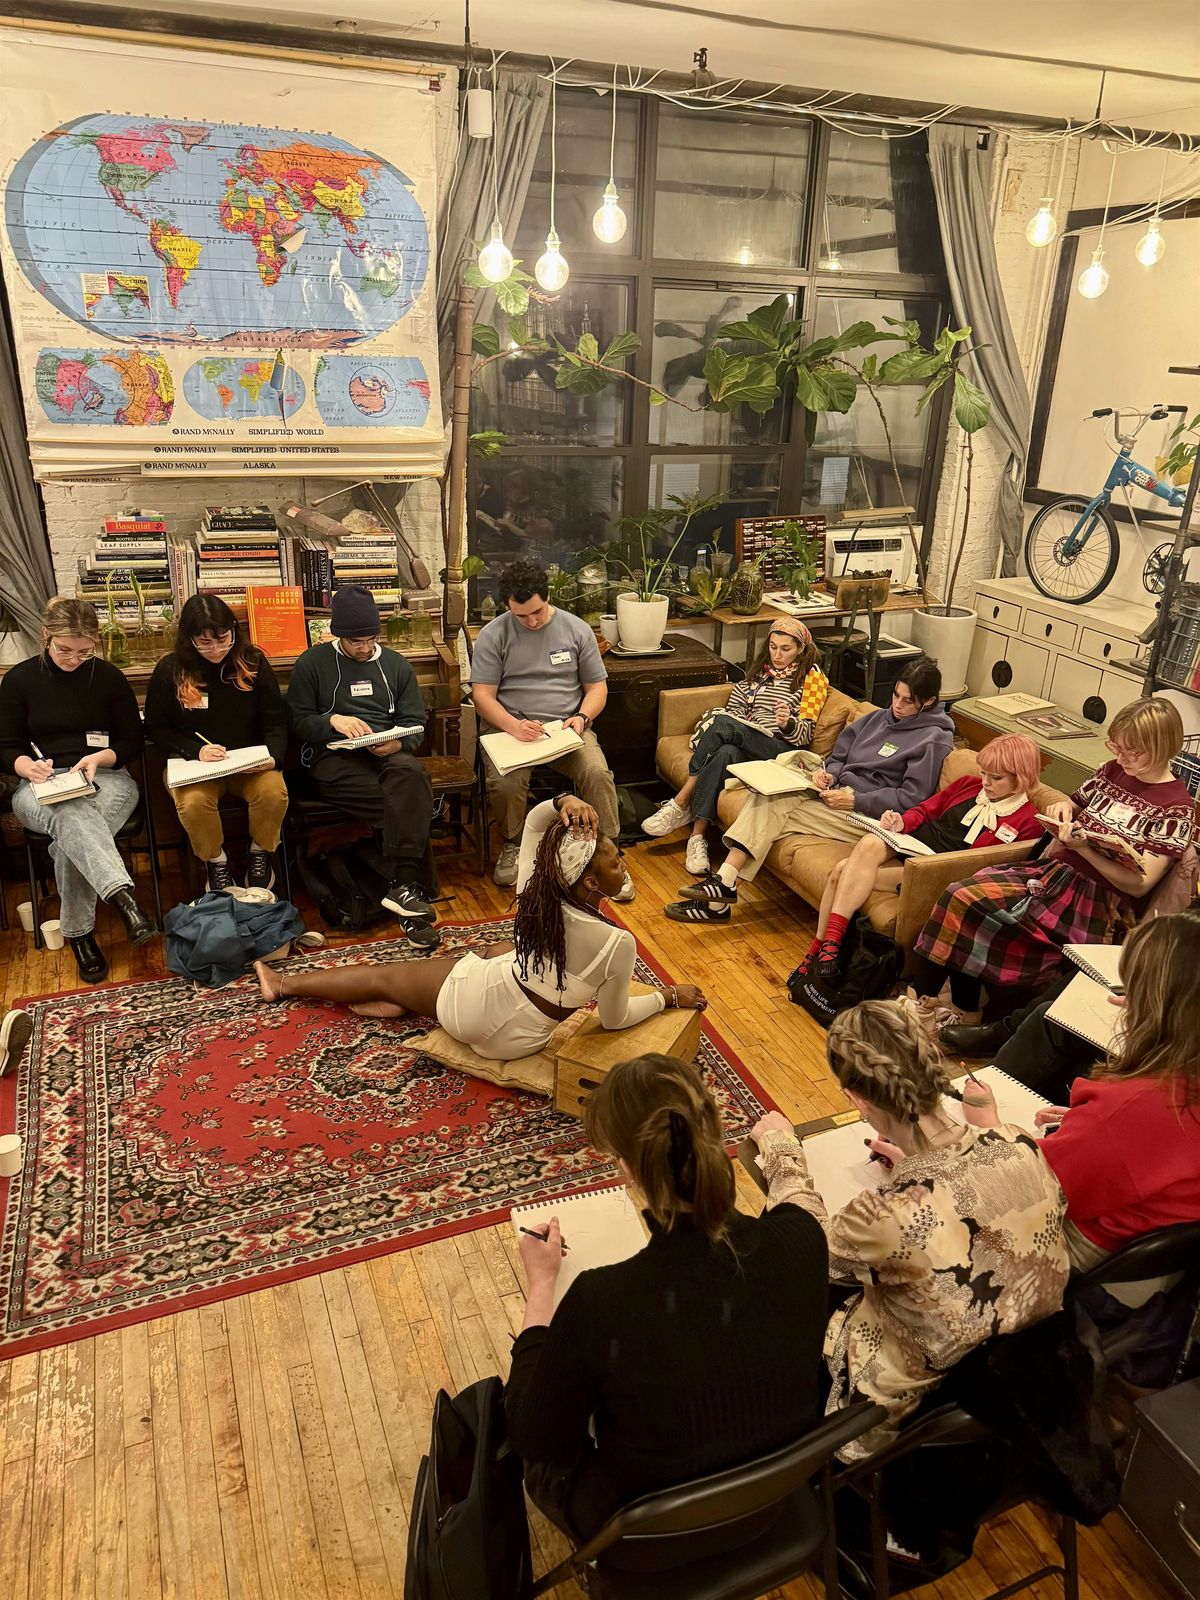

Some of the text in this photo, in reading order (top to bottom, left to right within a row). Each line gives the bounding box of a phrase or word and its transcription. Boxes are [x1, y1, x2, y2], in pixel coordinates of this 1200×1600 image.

[118, 151, 160, 159] CANADA
[16, 218, 77, 228] PACIFIC
[28, 262, 72, 270] OCEAN
[180, 428, 325, 436] RAND McNALLY SIMPLIFIED WORLD
[161, 446, 184, 454] RAND
[184, 446, 217, 454] McNALLY
[231, 446, 277, 454] SIMPLIFIED
[279, 446, 311, 454] UNITED
[115, 522, 152, 532] Basquiat
[211, 521, 234, 529] GRACE
[320, 552, 328, 587] FASHION
[809, 994, 837, 1015] EQUIPMENT
